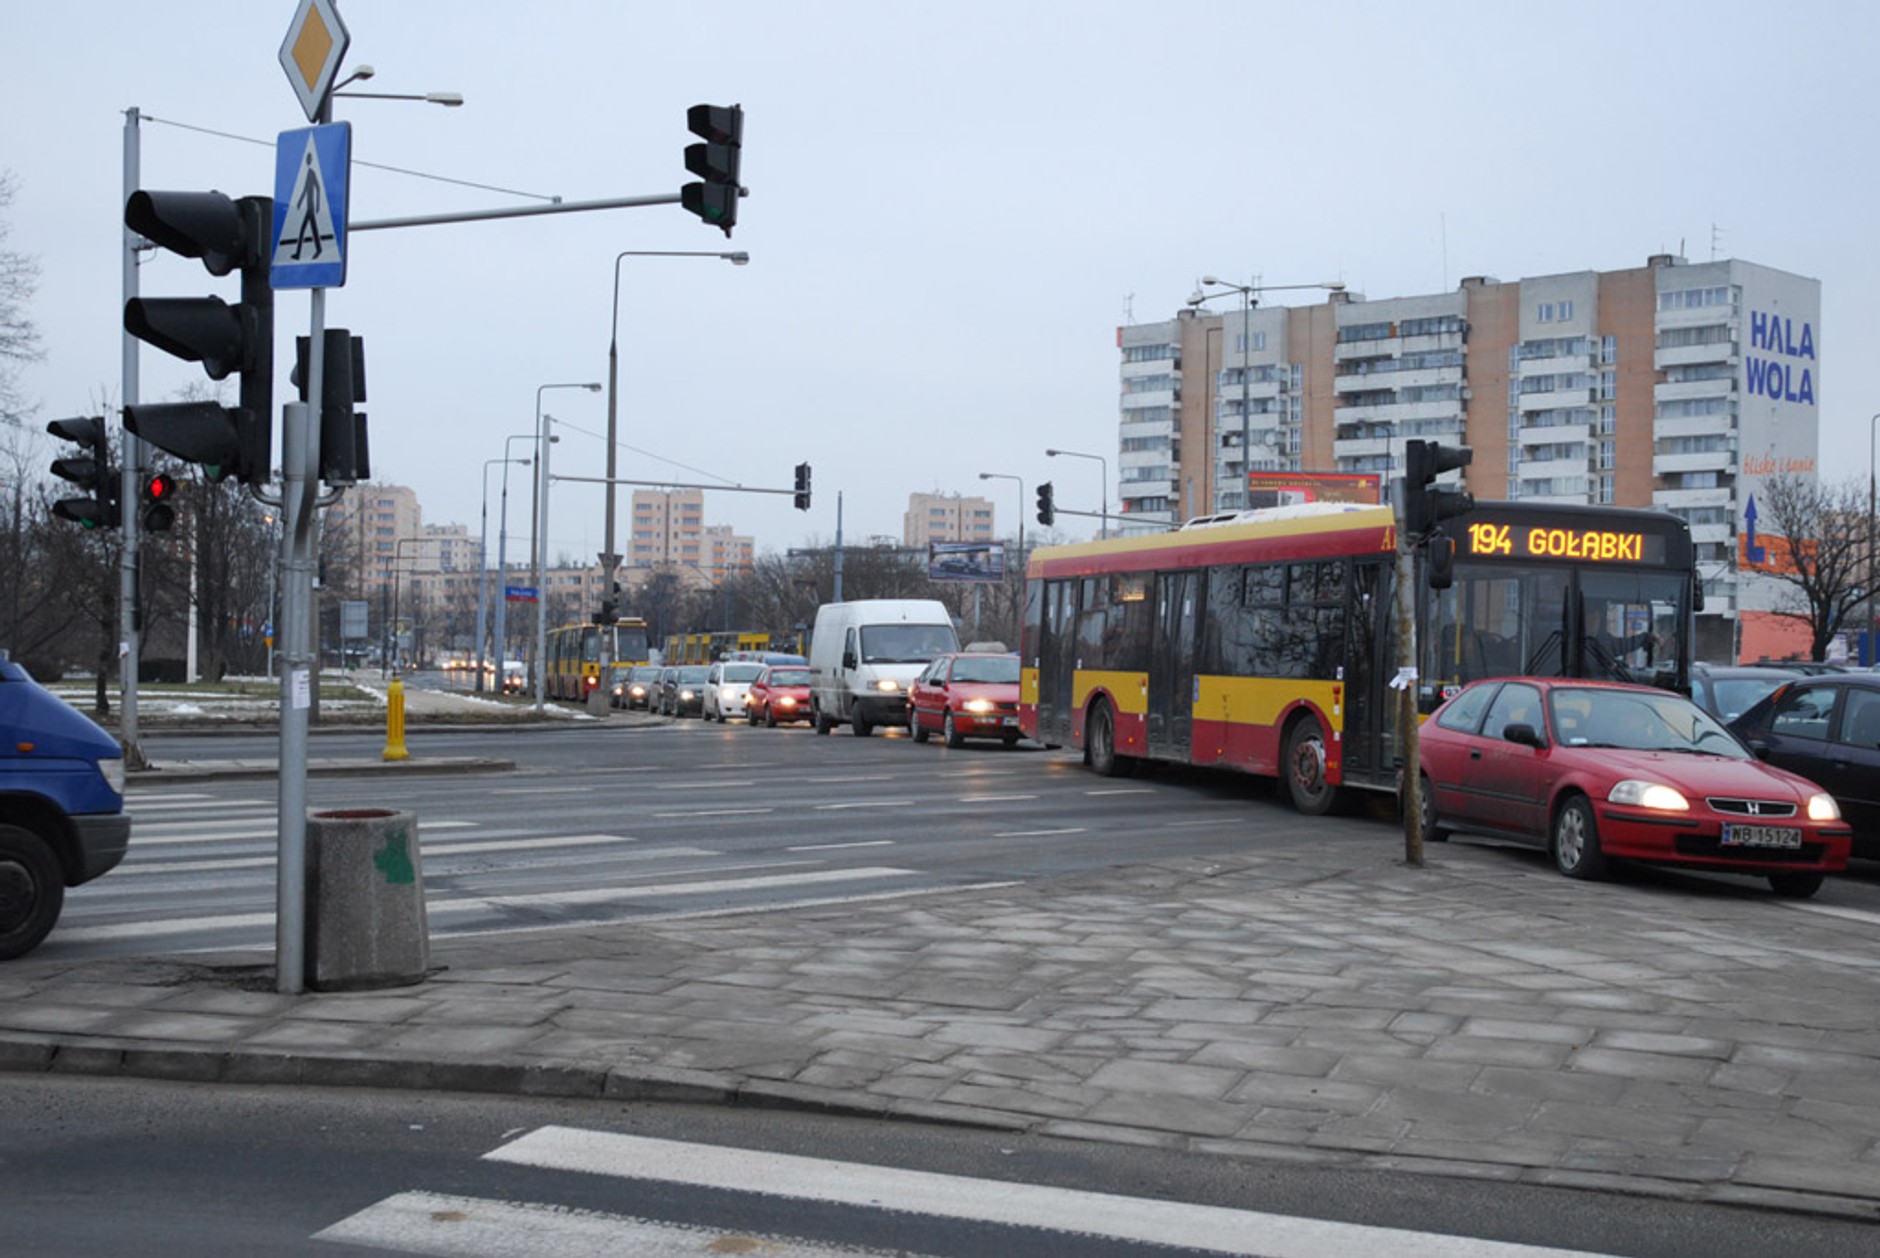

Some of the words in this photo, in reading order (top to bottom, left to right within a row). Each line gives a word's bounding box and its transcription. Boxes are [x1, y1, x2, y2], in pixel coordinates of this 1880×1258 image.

[1750, 310, 1815, 360] HALA
[1746, 356, 1814, 406] WOLA
[1468, 523, 1512, 555] 194
[1528, 528, 1643, 561] GOŁĄBKI
